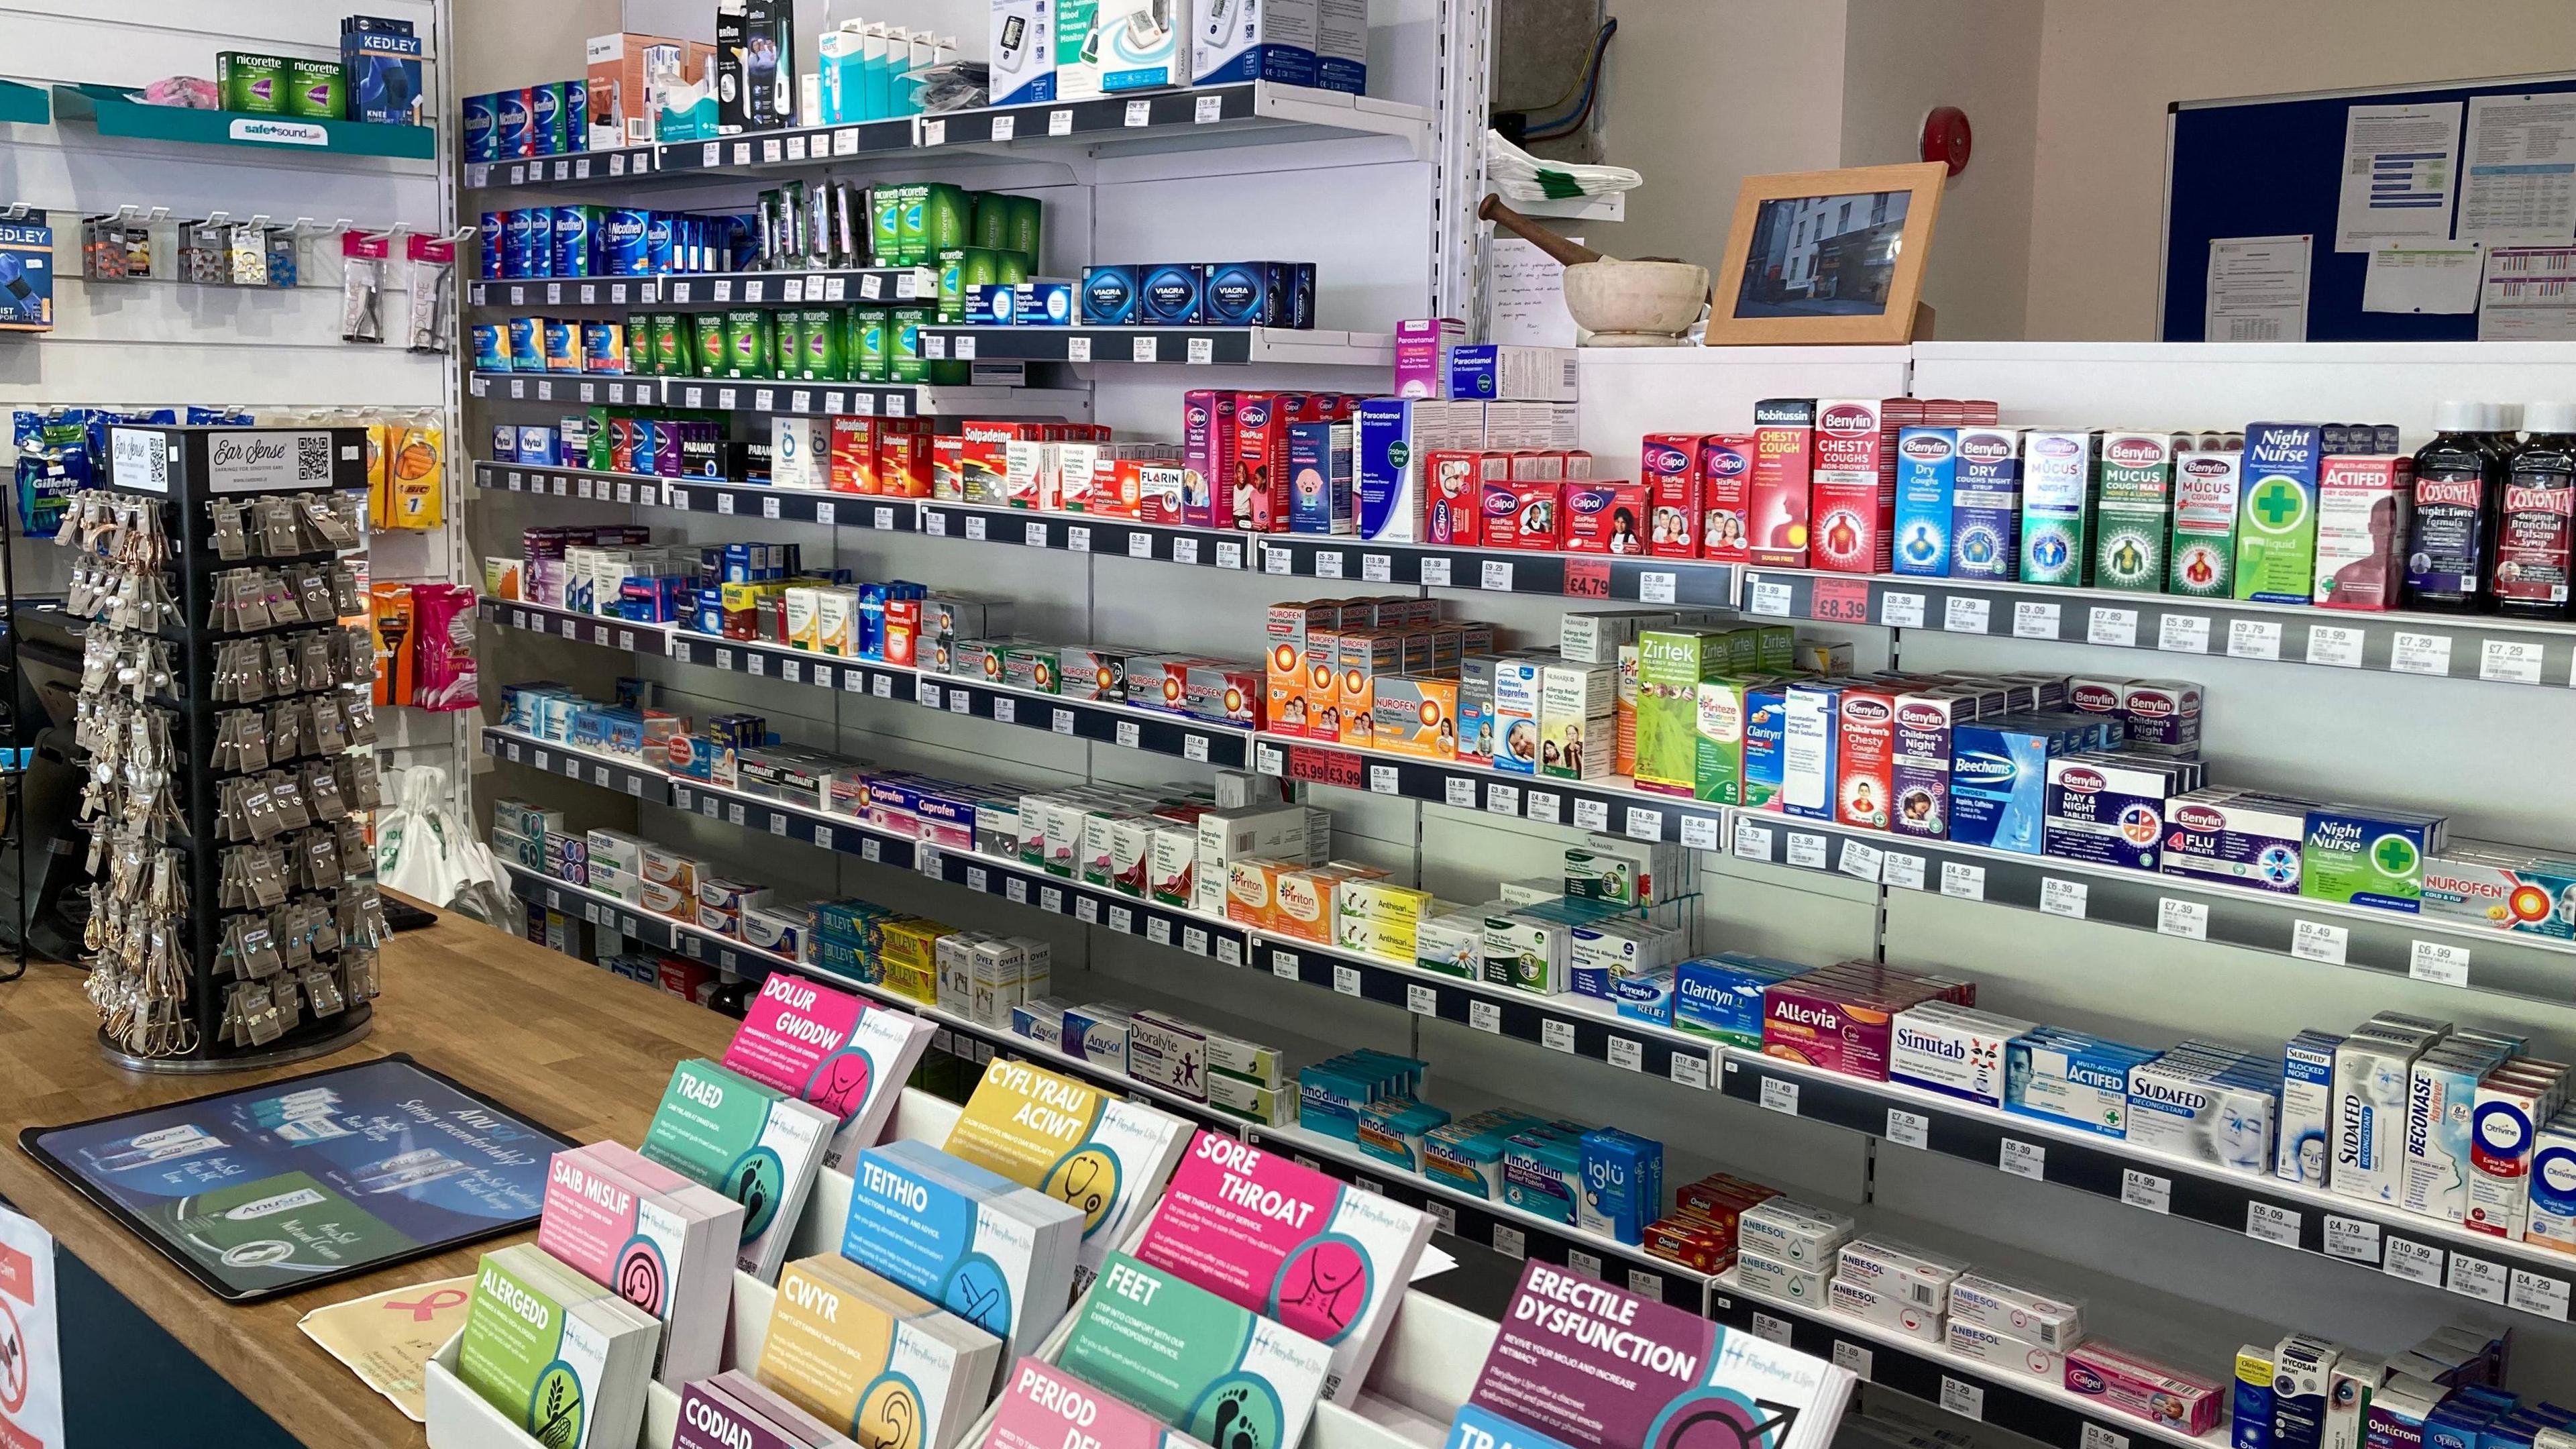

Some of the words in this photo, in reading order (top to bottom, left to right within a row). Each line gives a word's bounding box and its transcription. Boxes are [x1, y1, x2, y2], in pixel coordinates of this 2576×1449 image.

[1061, 10, 1079, 20] Blood
[719, 28, 739, 38] BRAUN
[1061, 21, 1086, 32] Pressure
[364, 36, 417, 52] KEDLEY
[1061, 33, 1084, 43] Monitor
[236, 54, 282, 69] nicorette
[294, 61, 339, 74] nicorette
[556, 220, 582, 232] Nicotinell
[612, 223, 641, 235] Nicotinell
[940, 251, 963, 260] nicorette
[729, 312, 757, 322] nicorette
[804, 311, 828, 321] nicorette
[859, 311, 883, 321] nicorette
[1241, 411, 1266, 424] Calpol
[1363, 411, 1400, 420] Paracetamol
[1757, 409, 1808, 423] Robitussin
[1826, 413, 1870, 430] Benylin
[835, 420, 868, 432] Solpadeine
[854, 432, 867, 441] PLUS
[965, 428, 1011, 443] Solpadeine
[1760, 431, 1801, 442] CHESTY
[2261, 431, 2309, 447] Night
[525, 438, 542, 449] Nytol
[684, 443, 716, 452] PARAMOL
[1760, 441, 1800, 454] COUGH
[1818, 440, 1874, 453] CHESTY
[1906, 440, 1951, 455] Benylin
[1964, 441, 2006, 456] Benylin
[213, 439, 243, 466] Ear
[246, 439, 285, 464] Sense
[1823, 452, 1869, 462] COUGHS
[2112, 445, 2160, 460] Benylin
[2253, 445, 2308, 462] Nurse
[1661, 456, 1685, 469] Calpol
[1715, 458, 1741, 470] Calpol
[1821, 463, 1870, 471] NON-DROWSY
[2186, 462, 2229, 474] Benylin
[1141, 472, 1179, 484] FLARIN
[1916, 464, 1935, 477] Dry
[1970, 465, 1997, 477] DRY
[2106, 470, 2161, 482] MUCUS
[2325, 470, 2387, 486] ACTIFED
[32, 477, 79, 490] Gillette
[1661, 476, 1684, 484] SixPlus
[1911, 476, 1938, 486] Coughs
[2106, 482, 2138, 490] COUGH
[2140, 483, 2161, 491] MAX
[1489, 497, 1515, 511] Calpol
[1573, 497, 1600, 511] Calpol
[1490, 518, 1514, 526] SixPlus
[2512, 520, 2561, 530] Bronchial
[2516, 530, 2554, 539] Balsam
[1570, 578, 1608, 596] £4.79
[1819, 600, 1866, 619] £8.39
[1951, 600, 1976, 609] £7.99
[2165, 617, 2194, 628] £5.99
[2235, 623, 2264, 635] £9.79
[1762, 633, 1791, 650] Zirtek
[1644, 640, 1695, 663] Zirtek
[2489, 644, 2522, 657] £7.29
[1061, 666, 1093, 676] NUROFEN
[1187, 686, 1221, 696] NUROFEN
[1498, 688, 1528, 699] Ibuprofen
[1377, 698, 1415, 710] NUROFEN
[1846, 702, 1885, 719] Benylin
[2131, 696, 2171, 711] Benylin
[1902, 708, 1943, 727] Benylin
[2128, 716, 2170, 727] Children's
[1747, 726, 1782, 740] Clarityn
[1842, 722, 1889, 737] Children's
[1899, 729, 1942, 741] Children's
[1905, 739, 1935, 751] Night
[1293, 762, 1324, 780] £3.99
[1955, 758, 2011, 775] Beechams
[1329, 767, 1360, 786] £3.99
[2064, 773, 2103, 789] Benylin
[871, 785, 904, 804] Cuprofen
[918, 799, 955, 817] Cuprofen
[1630, 809, 1654, 820] £14.99
[2063, 802, 2096, 812] NIGHT
[1684, 818, 1705, 828] £6.49
[2064, 811, 2095, 820] TABLETS
[2181, 810, 2223, 828] Benylin
[1738, 827, 1760, 837] £5.79
[2319, 822, 2361, 841] Night
[1791, 836, 1813, 845] £5.99
[2310, 834, 2360, 853] Nurse
[1235, 871, 1262, 892] Piriton
[2425, 874, 2502, 899] NUROFEN
[1285, 888, 1314, 907] Piriton
[1378, 899, 1406, 912] Anthisan
[2418, 944, 2450, 959] £6.99
[999, 955, 1018, 966] OVEX
[764, 977, 815, 1012] DOLUR
[1619, 981, 1652, 1001] Benadryl
[1681, 977, 1732, 1006] Clarityn
[1776, 1000, 1836, 1030] Allevia
[775, 1012, 841, 1050] GWDDW
[1131, 1023, 1178, 1053] Dioralyte
[1897, 1028, 1964, 1061] Sinutab
[2289, 1049, 2326, 1063] SUDAFED
[2076, 1061, 2123, 1075] MULTI-ACTION
[2288, 1063, 2324, 1077] BLOCKED
[2288, 1069, 2309, 1079] NOSE
[2068, 1067, 2123, 1090] ACTIFED
[676, 1072, 722, 1109] TRAED
[987, 1063, 1085, 1112] CYFLYRAU
[2135, 1078, 2206, 1110] SUDAFED
[1302, 1085, 1349, 1107] Imodium
[1302, 1096, 1321, 1107] Classic
[2429, 1081, 2443, 1122] Hayfever
[1012, 1102, 1082, 1142] ACIWT
[2409, 1072, 2431, 1157] BECONASE
[396, 1099, 437, 1124] Sitting
[434, 1113, 535, 1167] uncomfortably?
[1360, 1117, 1405, 1140] Imodium
[2339, 1095, 2360, 1167] SUDAFED
[2487, 1124, 2516, 1136] Otrivine
[1195, 1135, 1260, 1176] SORE
[1426, 1142, 1476, 1167] Imodium
[2006, 1142, 2030, 1156] £6.39
[1508, 1152, 1563, 1179] Imodium
[1588, 1157, 1624, 1189] iglü
[863, 1162, 927, 1213] TEITHIO
[2129, 1174, 2155, 1187] £4.99
[553, 1161, 584, 1193] SAIB
[586, 1175, 631, 1216] MISLIF
[1221, 1175, 1314, 1230] THROAT
[2253, 1206, 2283, 1221] £6.09
[2392, 1242, 2430, 1258] £10.99
[1740, 1255, 1786, 1275] ANBESOL
[1842, 1254, 1884, 1275] ANBESOL
[1106, 1262, 1162, 1306] FEET
[480, 1269, 548, 1330] ALERGEDD
[784, 1275, 839, 1324] CWYR
[1527, 1267, 1639, 1326] ERECTILE
[1833, 1283, 1876, 1304] ANBESOL
[1953, 1288, 1998, 1311] ANBESOL
[1091, 1311, 1113, 1327] EXPERT
[1113, 1322, 1152, 1345] CHIROPODIST
[1095, 1301, 1110, 1313] STEP
[1110, 1307, 1124, 1321] INTO
[1124, 1316, 1155, 1334] COMFORT
[1154, 1327, 1171, 1342] WITH
[1171, 1336, 1185, 1349] OUR
[1515, 1294, 1697, 1382] DYSFUNCTION
[1951, 1324, 1998, 1346] ANBESOL
[1837, 1344, 1858, 1357] £3.69
[2282, 1358, 2316, 1373] HYCOSAN
[2282, 1366, 2298, 1376] NIGHT
[2073, 1371, 2101, 1390] Calgel
[1017, 1368, 1097, 1427] PERIOD
[686, 1397, 752, 1449] CODIAD
[2369, 1419, 2420, 1442] Opticrom
[2369, 1434, 2387, 1444] Allergy
